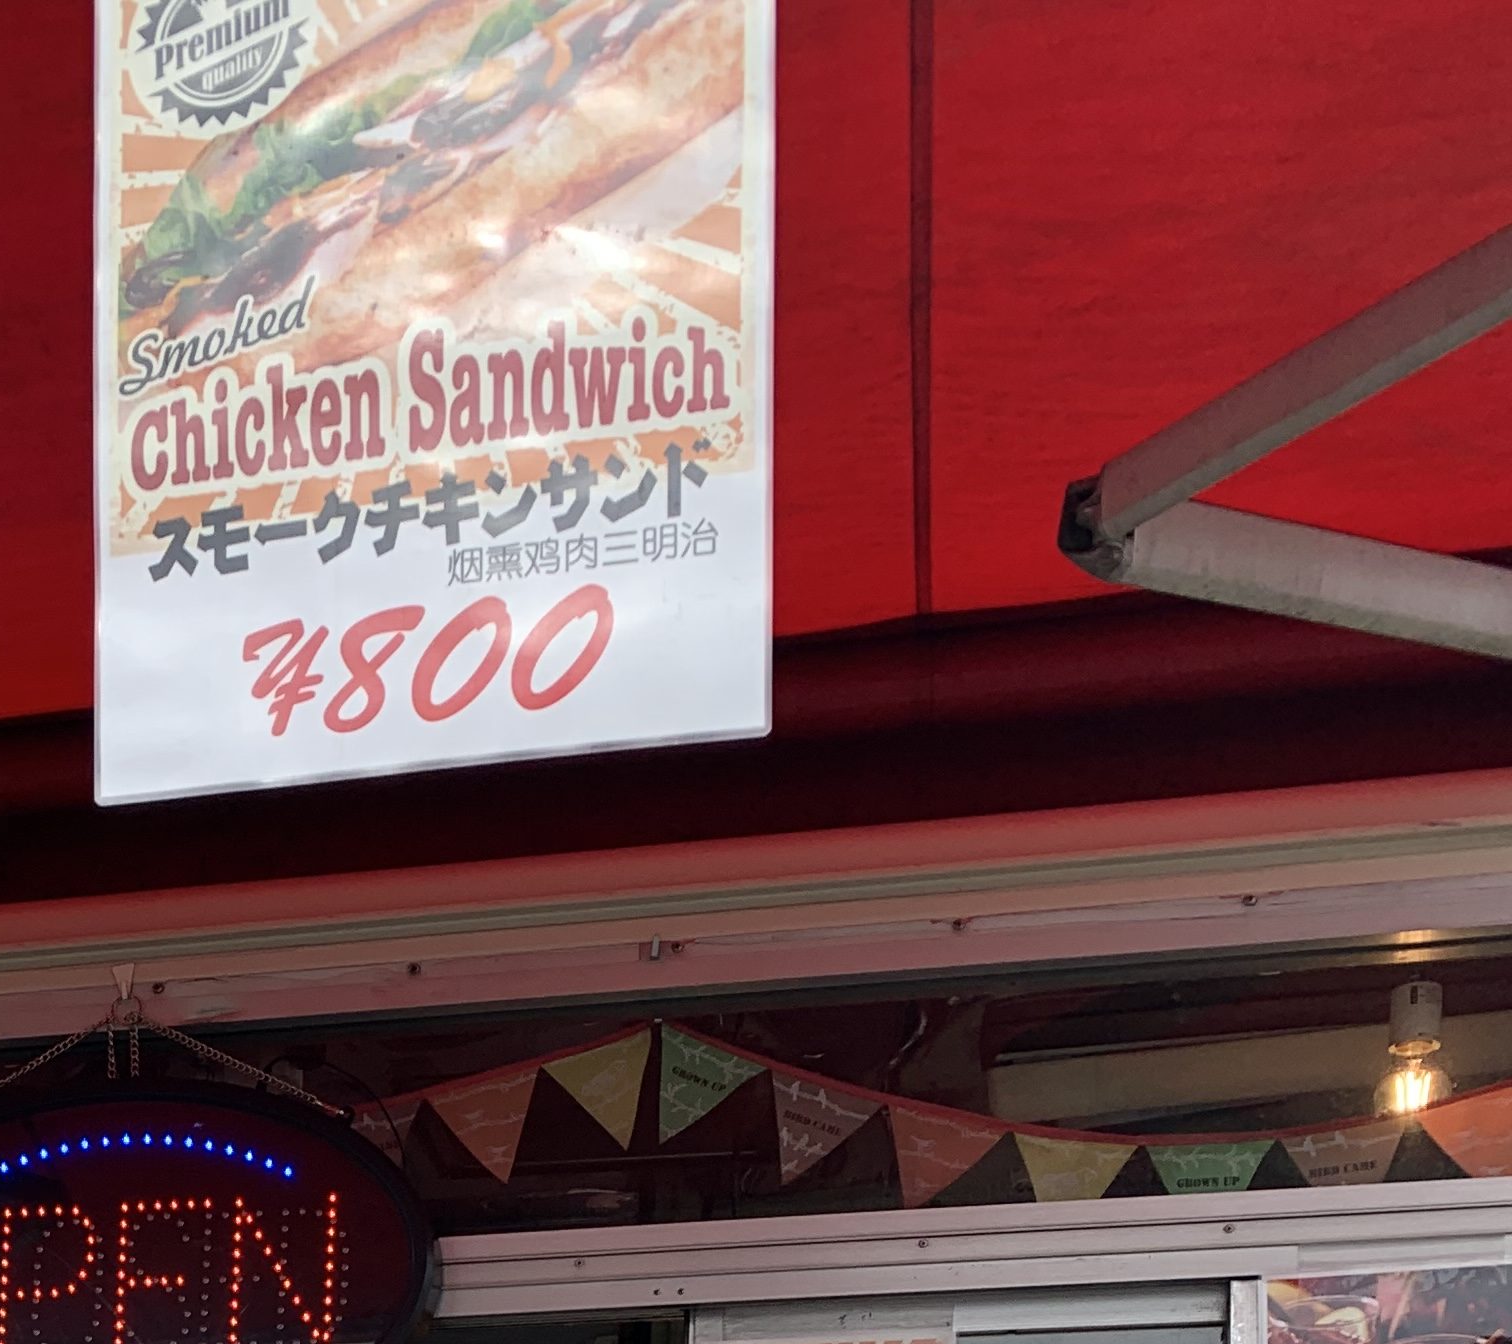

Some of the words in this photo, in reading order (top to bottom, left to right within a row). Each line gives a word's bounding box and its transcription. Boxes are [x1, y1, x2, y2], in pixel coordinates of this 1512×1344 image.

[119, 275, 317, 397] Smoked
[130, 365, 386, 492] Chicken
[407, 316, 730, 455] Sandwich
[148, 438, 711, 583] スモークチキンサンド
[243, 582, 614, 737] ¥800
